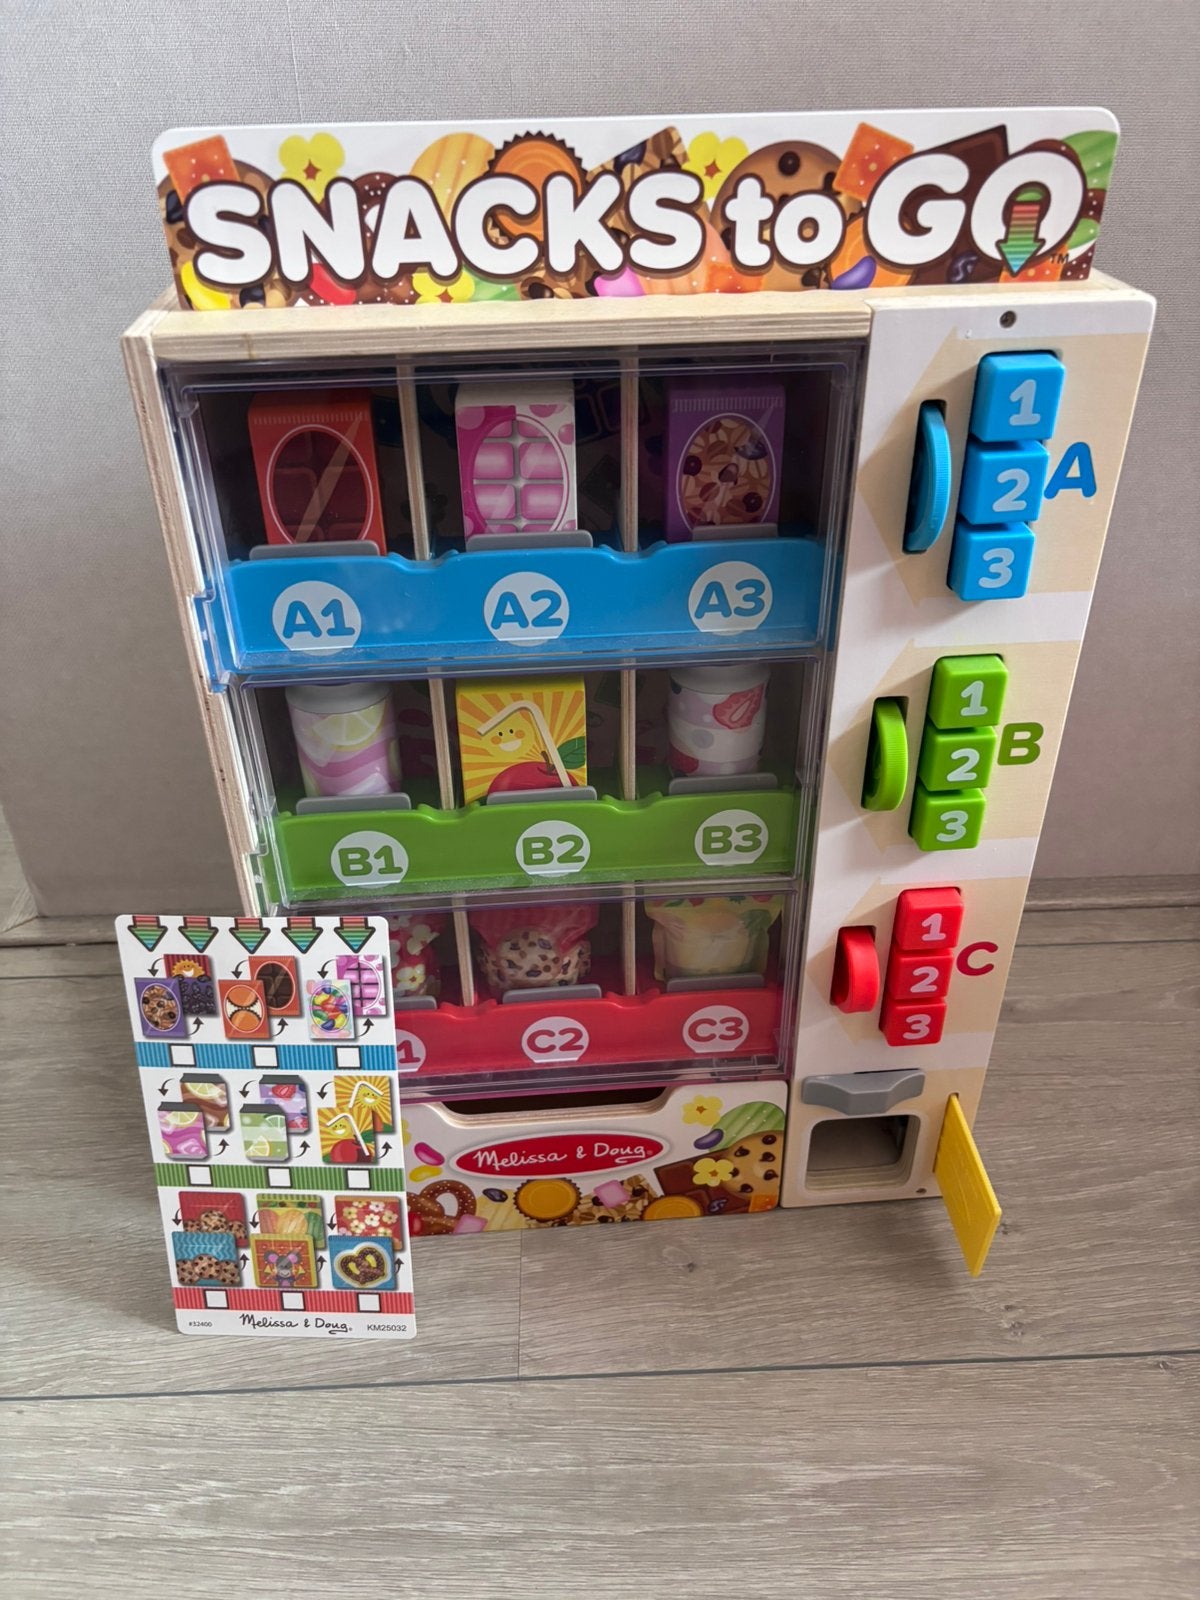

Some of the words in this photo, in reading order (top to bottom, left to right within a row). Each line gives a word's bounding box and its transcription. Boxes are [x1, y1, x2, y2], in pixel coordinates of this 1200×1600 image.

[187, 172, 703, 285] SNACKS
[725, 178, 844, 266] to
[866, 151, 1083, 275] GO
[1009, 379, 1041, 426] 1
[1043, 441, 1097, 499] A
[992, 468, 1030, 513] 2
[978, 548, 1015, 589] 3
[490, 589, 564, 630] A2
[694, 578, 766, 619] A3
[282, 600, 355, 639] A1
[960, 680, 988, 716] 1
[997, 722, 1044, 766] B
[946, 748, 980, 782] 2
[701, 823, 763, 854] B3
[936, 810, 968, 842] 3
[338, 845, 403, 877] B1
[522, 834, 585, 866] B2
[921, 913, 946, 942] 1
[956, 941, 999, 977] C
[910, 966, 939, 993] 2
[526, 1027, 584, 1053] C2
[688, 1016, 743, 1042] C3
[902, 1013, 931, 1040] 3
[396, 1039, 421, 1064] 1
[473, 1149, 568, 1171] Melissa
[576, 1145, 587, 1159] &
[239, 1313, 299, 1329] Melissa
[303, 1318, 311, 1328] &
[366, 1324, 407, 1332] KM25032
